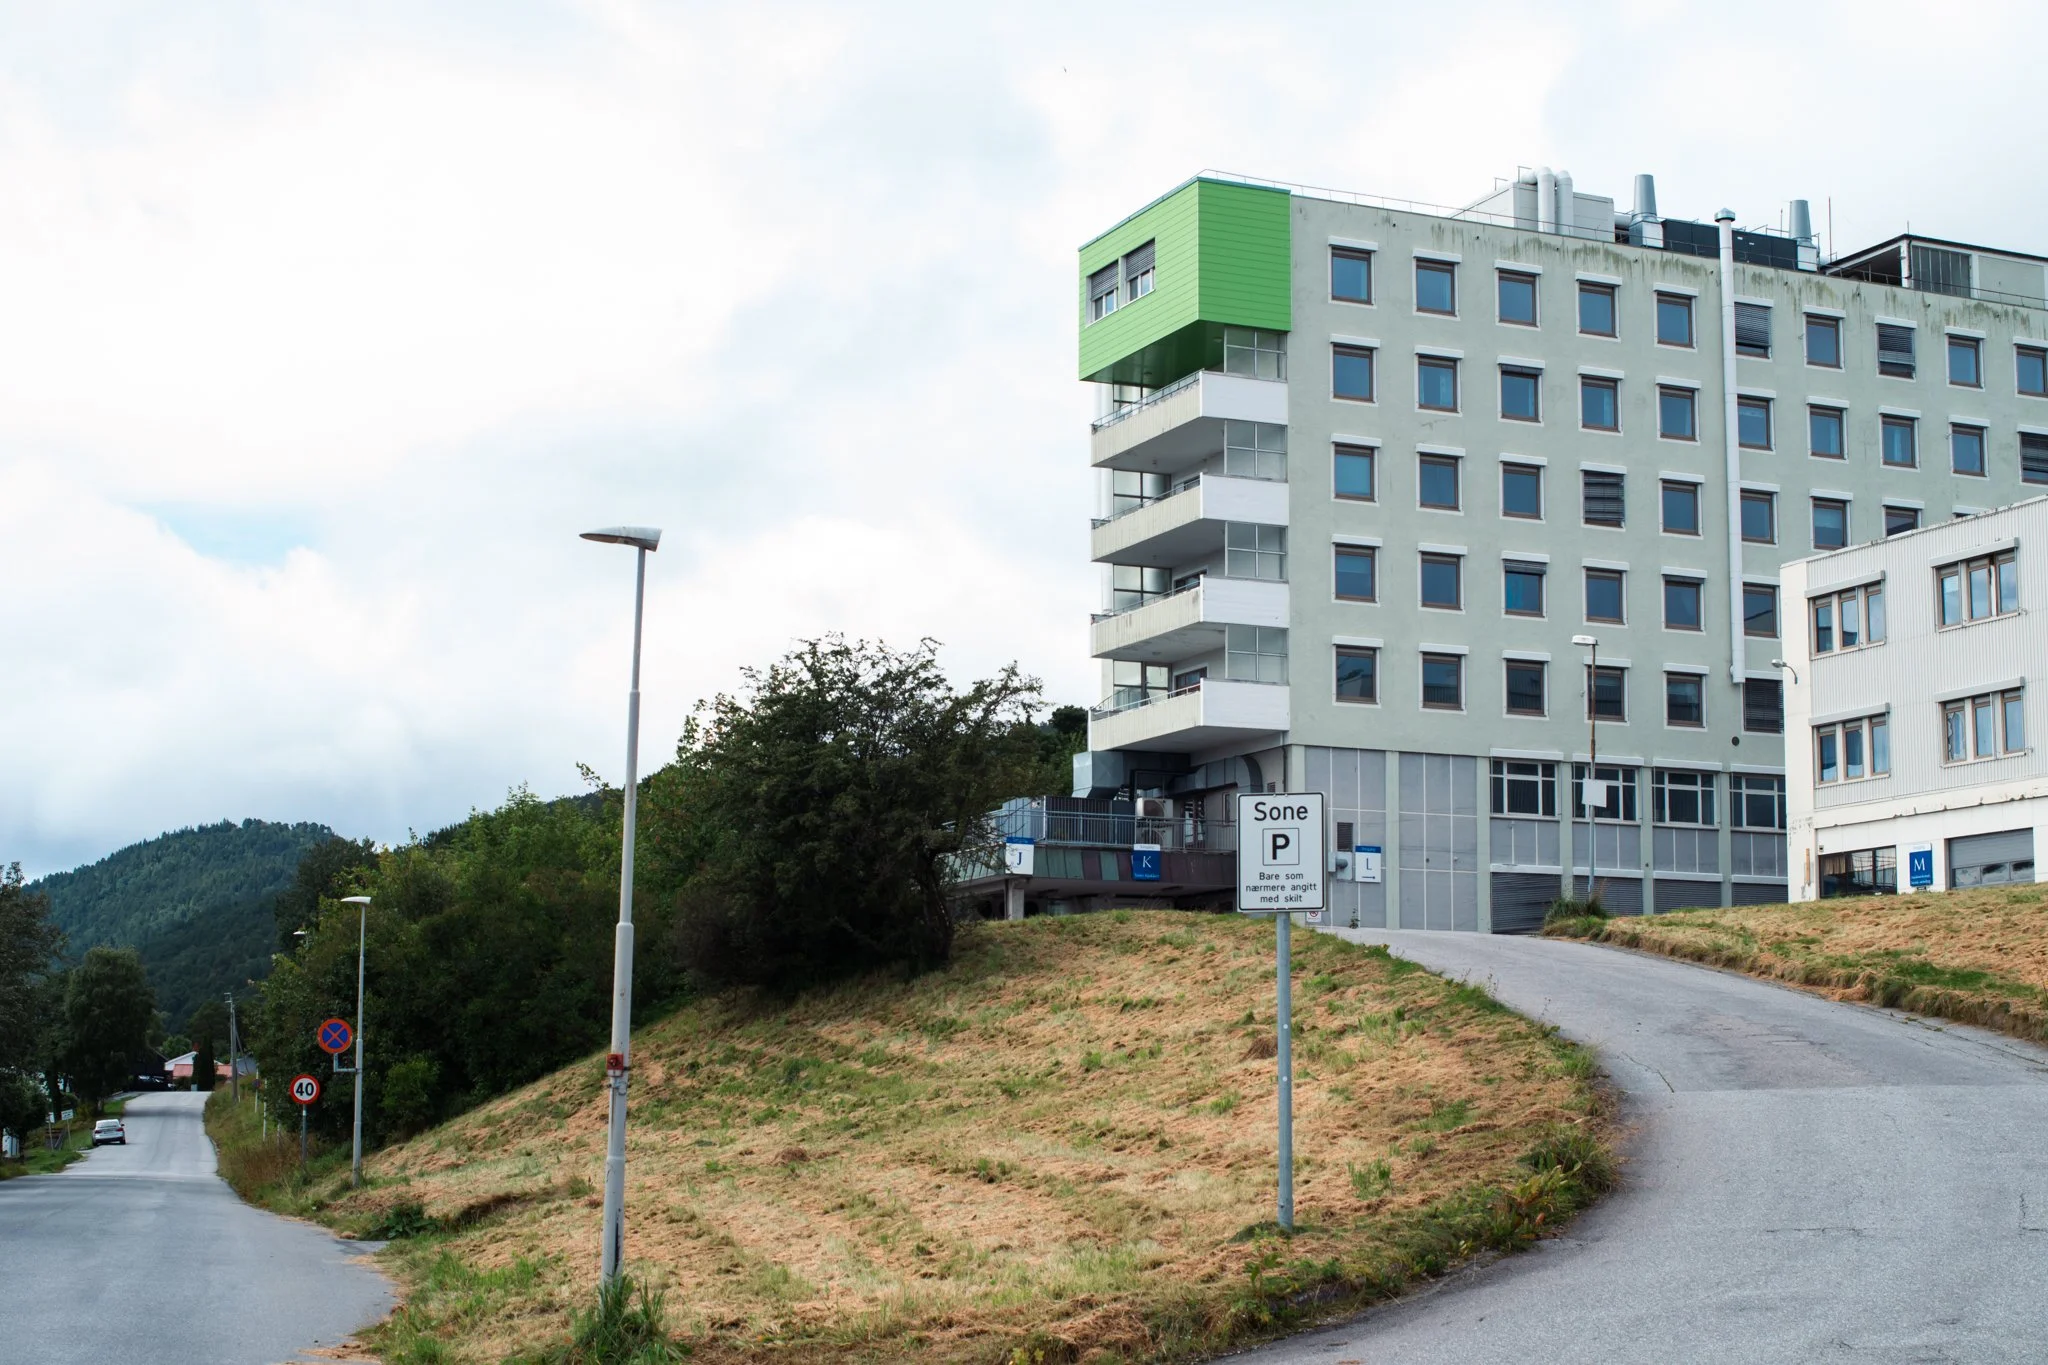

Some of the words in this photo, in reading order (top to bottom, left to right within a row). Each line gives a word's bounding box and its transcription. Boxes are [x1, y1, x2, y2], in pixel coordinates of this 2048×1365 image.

[1254, 801, 1308, 821] Sone
[1272, 833, 1290, 860] P
[1017, 852, 1022, 865] J
[1142, 855, 1151, 868] K
[1366, 857, 1372, 870] L
[1914, 857, 1925, 872] M
[1259, 872, 1279, 880] Bare
[1285, 872, 1303, 880] som
[1245, 884, 1286, 892] nærmere
[1291, 882, 1317, 893] angitt
[1260, 894, 1279, 903] med
[1284, 894, 1302, 903] skilt
[296, 1082, 314, 1096] 40
